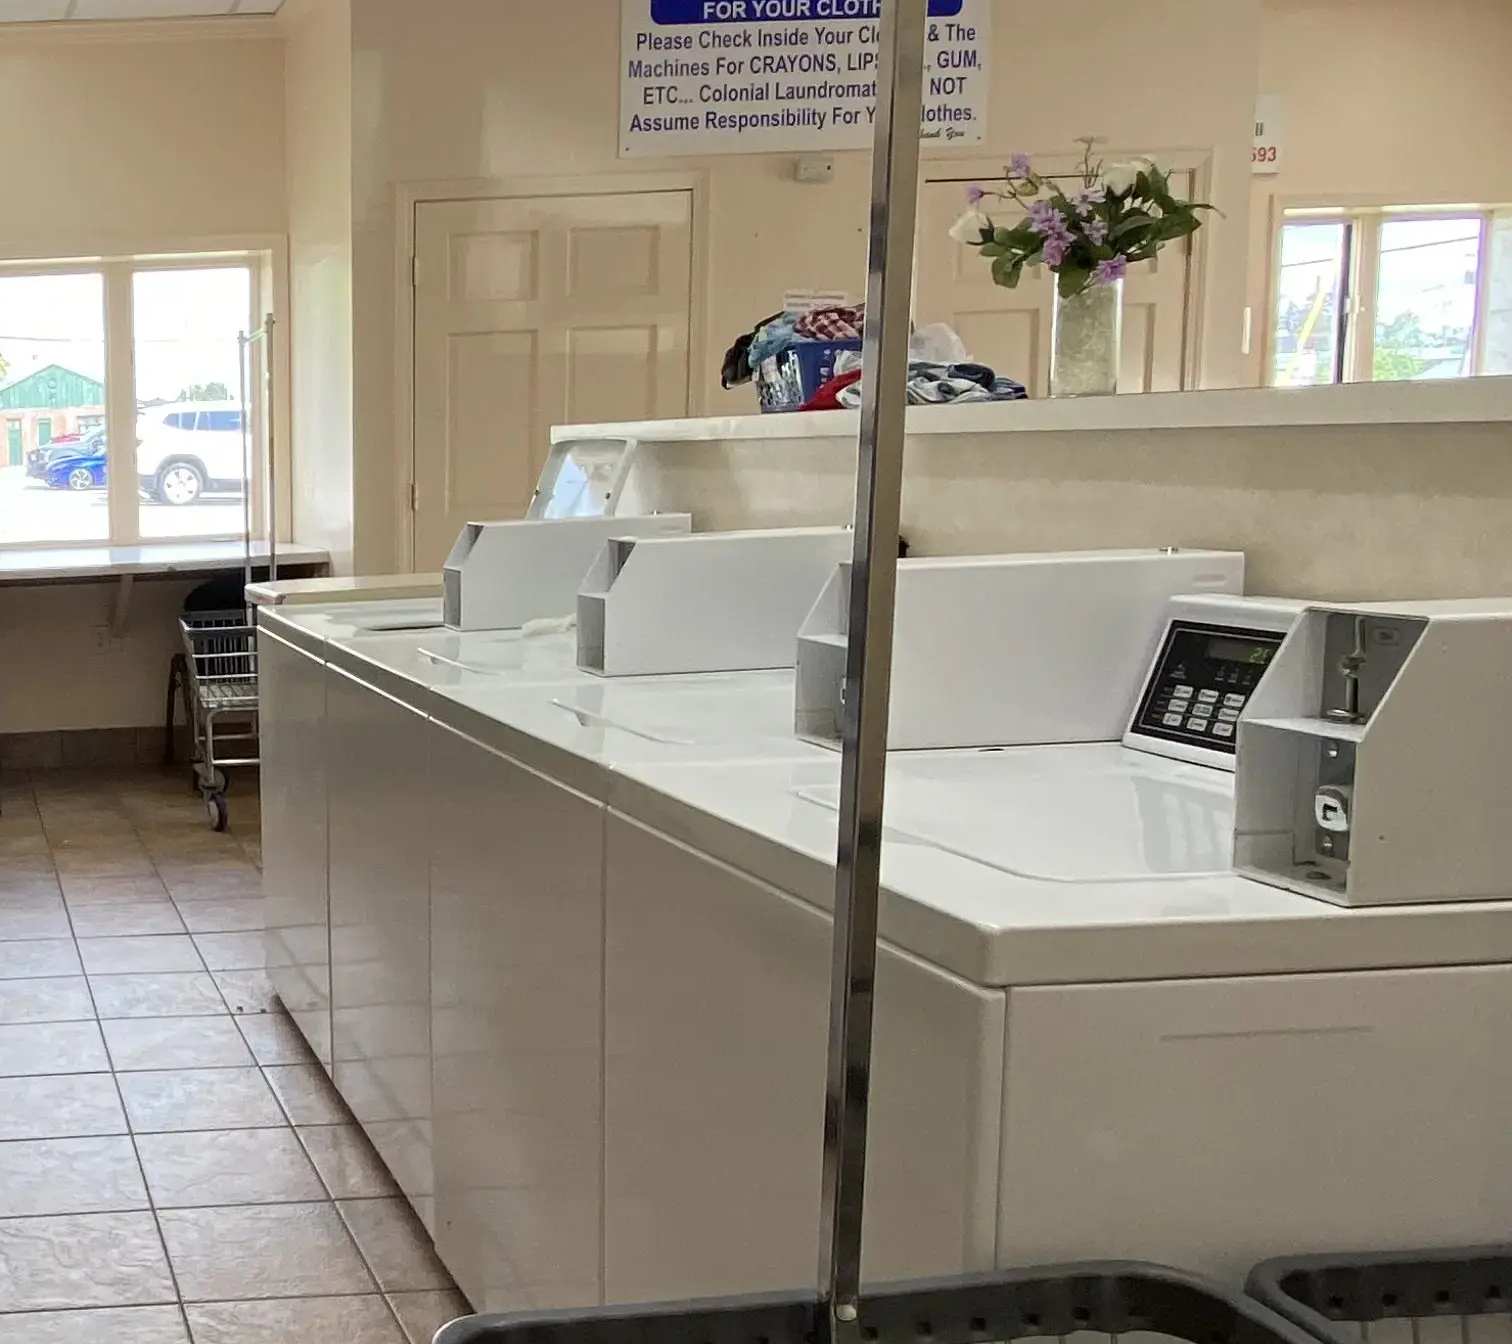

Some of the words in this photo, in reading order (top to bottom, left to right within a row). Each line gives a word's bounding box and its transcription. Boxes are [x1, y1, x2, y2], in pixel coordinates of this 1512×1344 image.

[703, 0, 747, 20] FOR
[636, 32, 693, 51] Please
[698, 29, 752, 49] Check
[758, 27, 809, 47] Inside
[815, 26, 854, 45] Your
[927, 23, 939, 42] &
[945, 23, 976, 42] The
[628, 58, 710, 79] Machines
[716, 56, 745, 75] For
[750, 52, 841, 75] CRAYONS,
[937, 49, 982, 71] GUM,
[643, 85, 693, 105] ETC...
[699, 82, 770, 103] Colonial
[775, 80, 877, 101] Laundromat
[929, 76, 968, 96] NOT
[629, 113, 700, 133] Assume
[705, 108, 827, 133] Responsibility
[832, 107, 861, 126] For
[921, 104, 977, 123] lothes.
